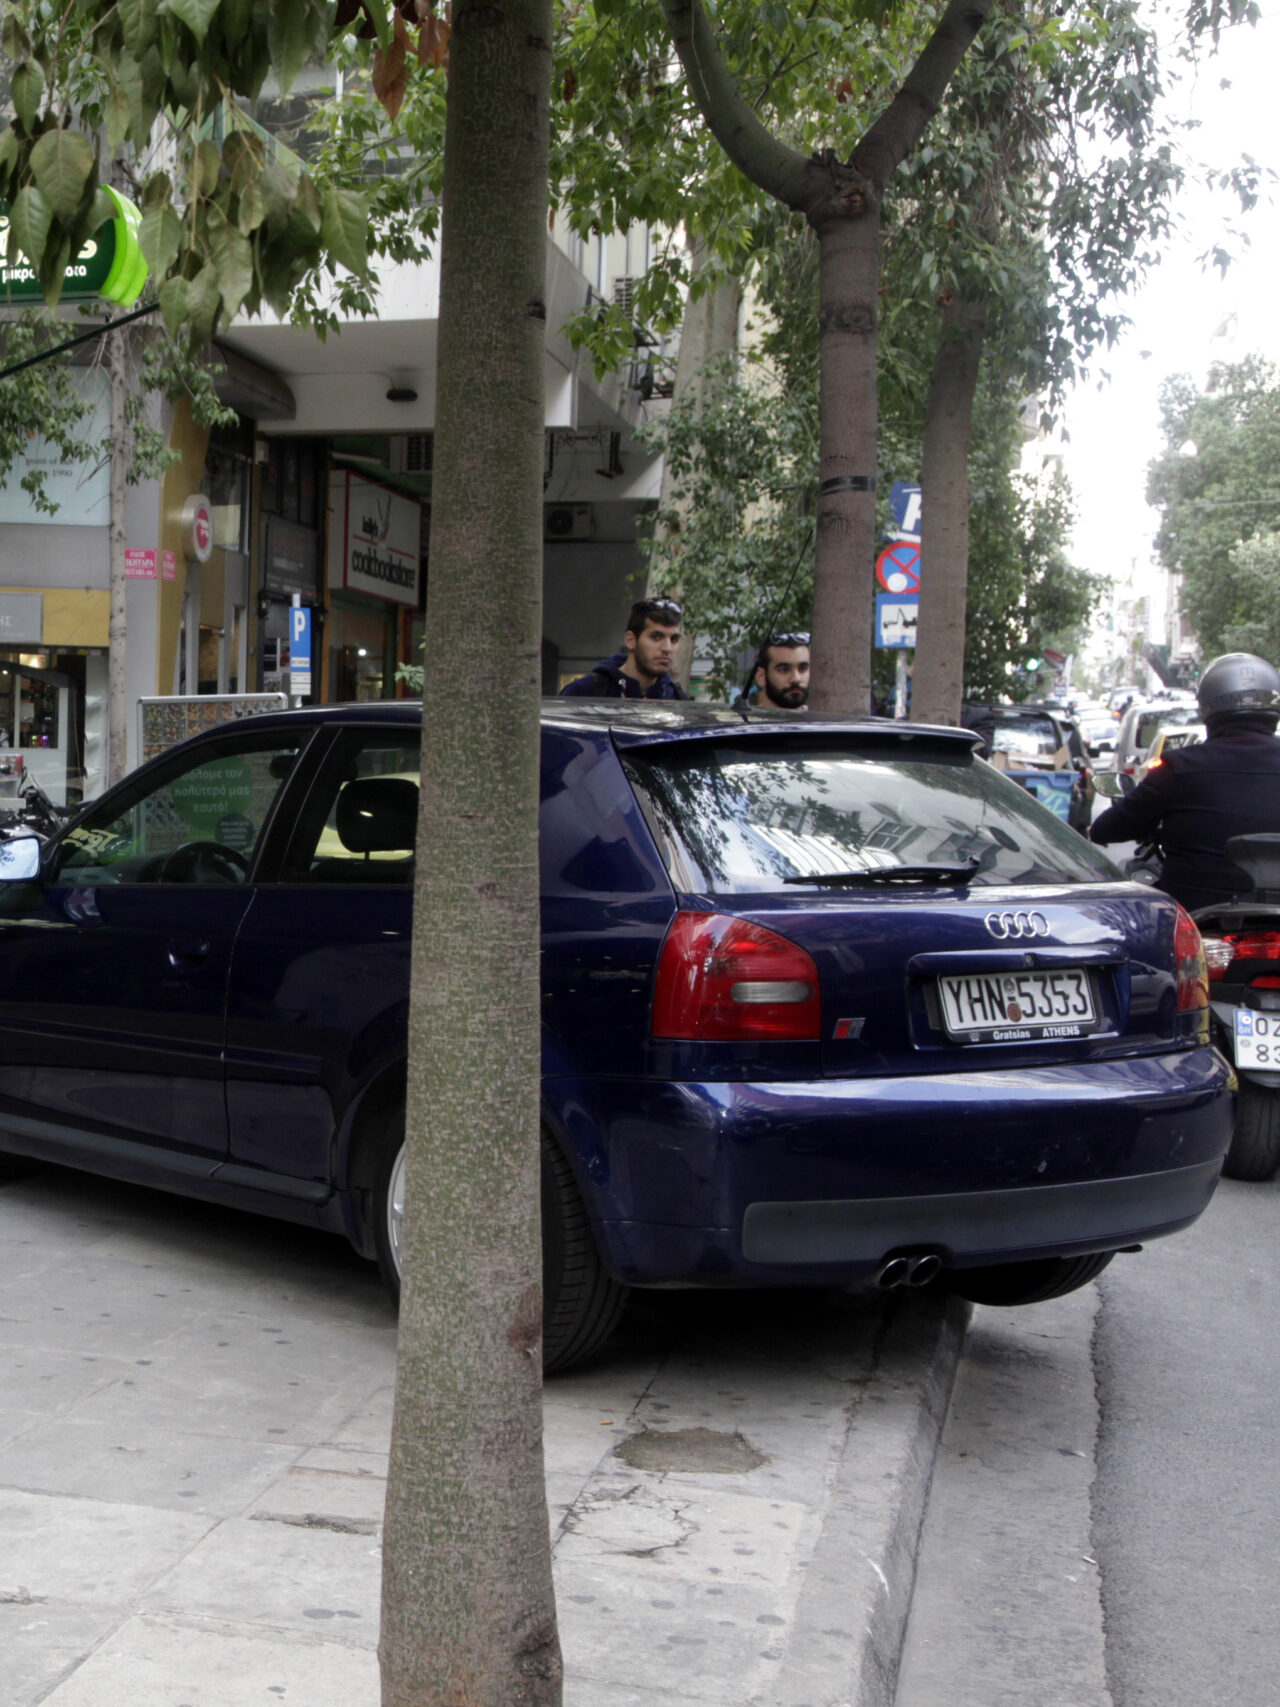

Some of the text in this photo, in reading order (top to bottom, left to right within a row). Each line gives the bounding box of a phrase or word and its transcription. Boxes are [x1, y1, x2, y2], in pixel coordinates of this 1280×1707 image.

[293, 610, 306, 642] P
[174, 783, 227, 799] καλύτερό
[192, 800, 229, 813] εαυτό!
[993, 1025, 1080, 1041] Gratsias ATHENS
